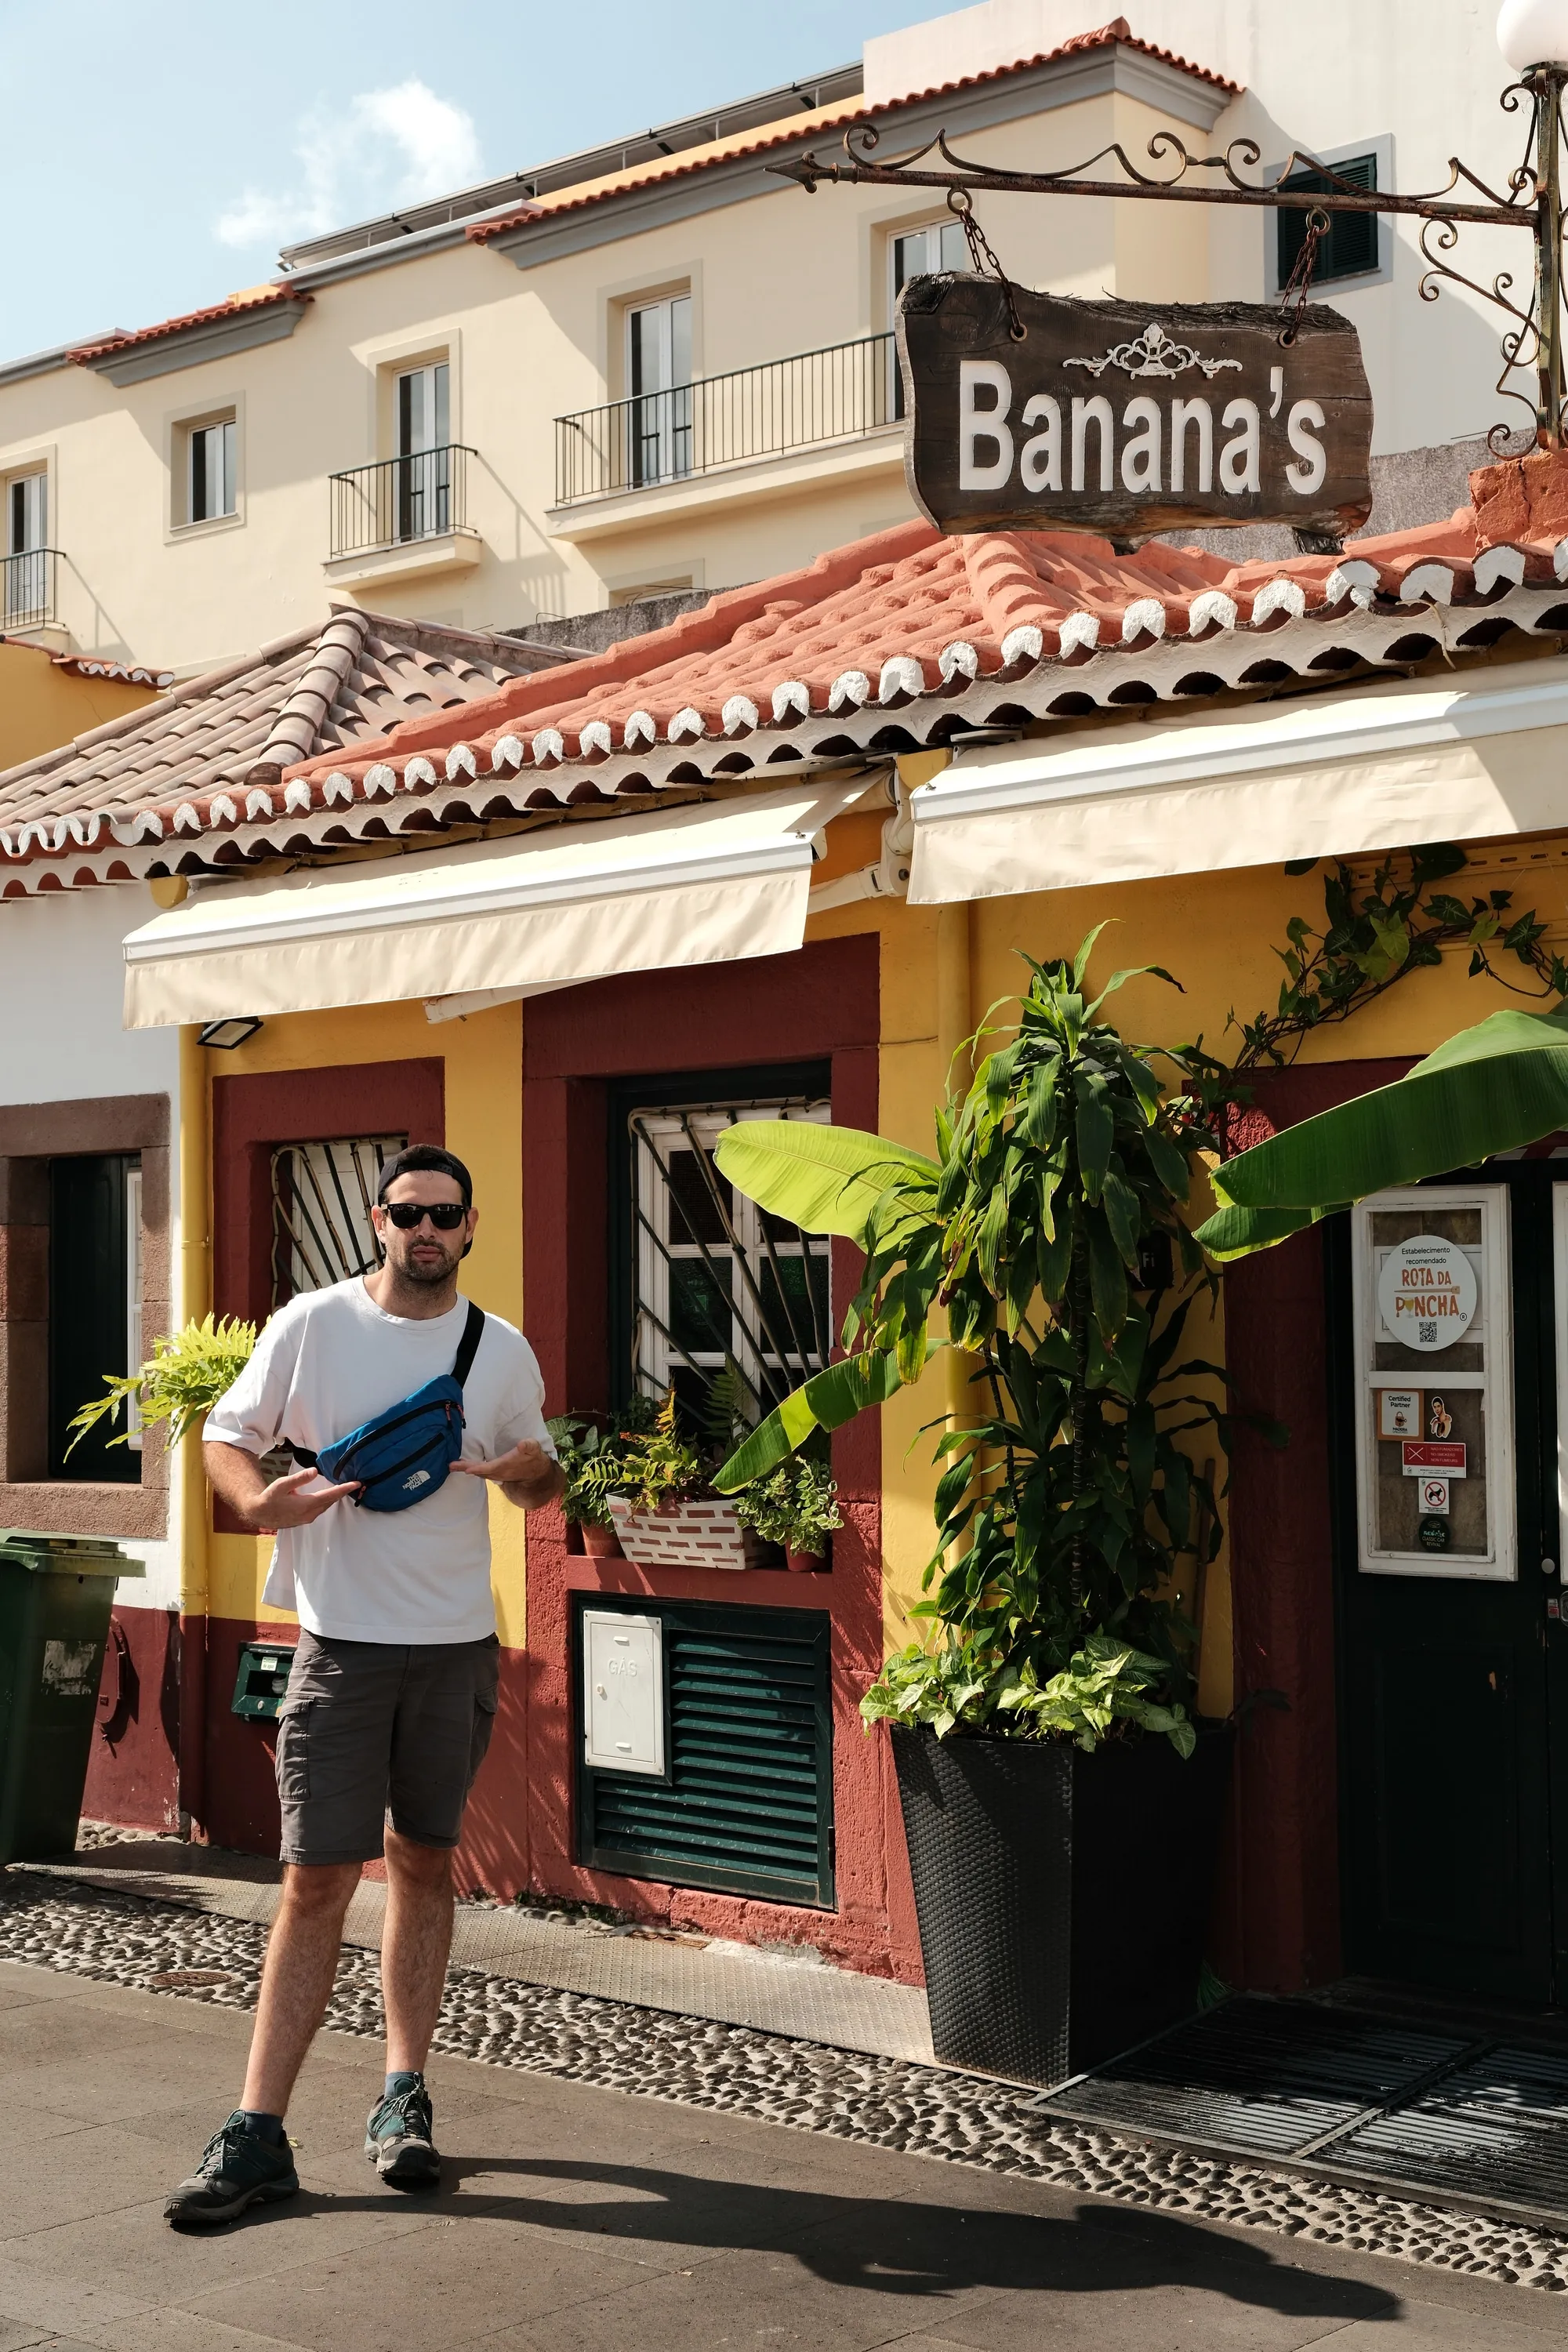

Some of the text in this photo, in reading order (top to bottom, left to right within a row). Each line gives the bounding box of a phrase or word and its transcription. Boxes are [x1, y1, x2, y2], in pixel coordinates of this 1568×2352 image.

[960, 360, 1327, 494] Banana's
[1401, 1247, 1450, 1255] Estabelecimento
[1402, 1268, 1452, 1287] ROTA DA
[1396, 1295, 1460, 1318] PNCHA
[402, 1477, 421, 1490] NORTH
[608, 1657, 637, 1677] GÁS
